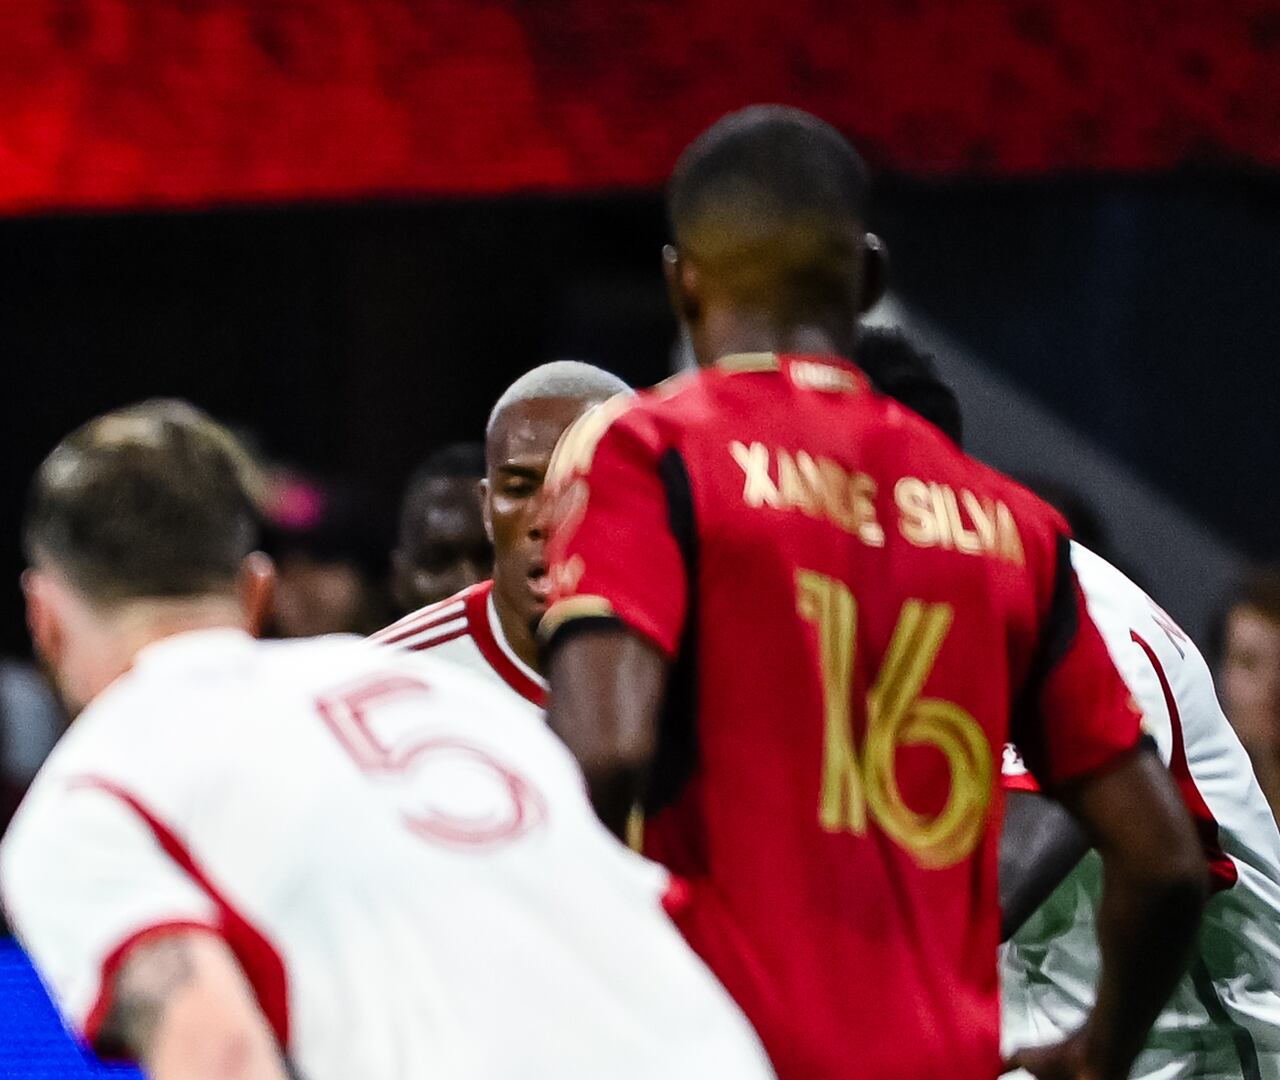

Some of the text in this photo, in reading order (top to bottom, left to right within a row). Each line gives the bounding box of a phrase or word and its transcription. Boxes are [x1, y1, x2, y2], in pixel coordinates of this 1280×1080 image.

[729, 440, 885, 548] XANE
[312, 668, 550, 852] 5
[794, 568, 993, 870] 16
